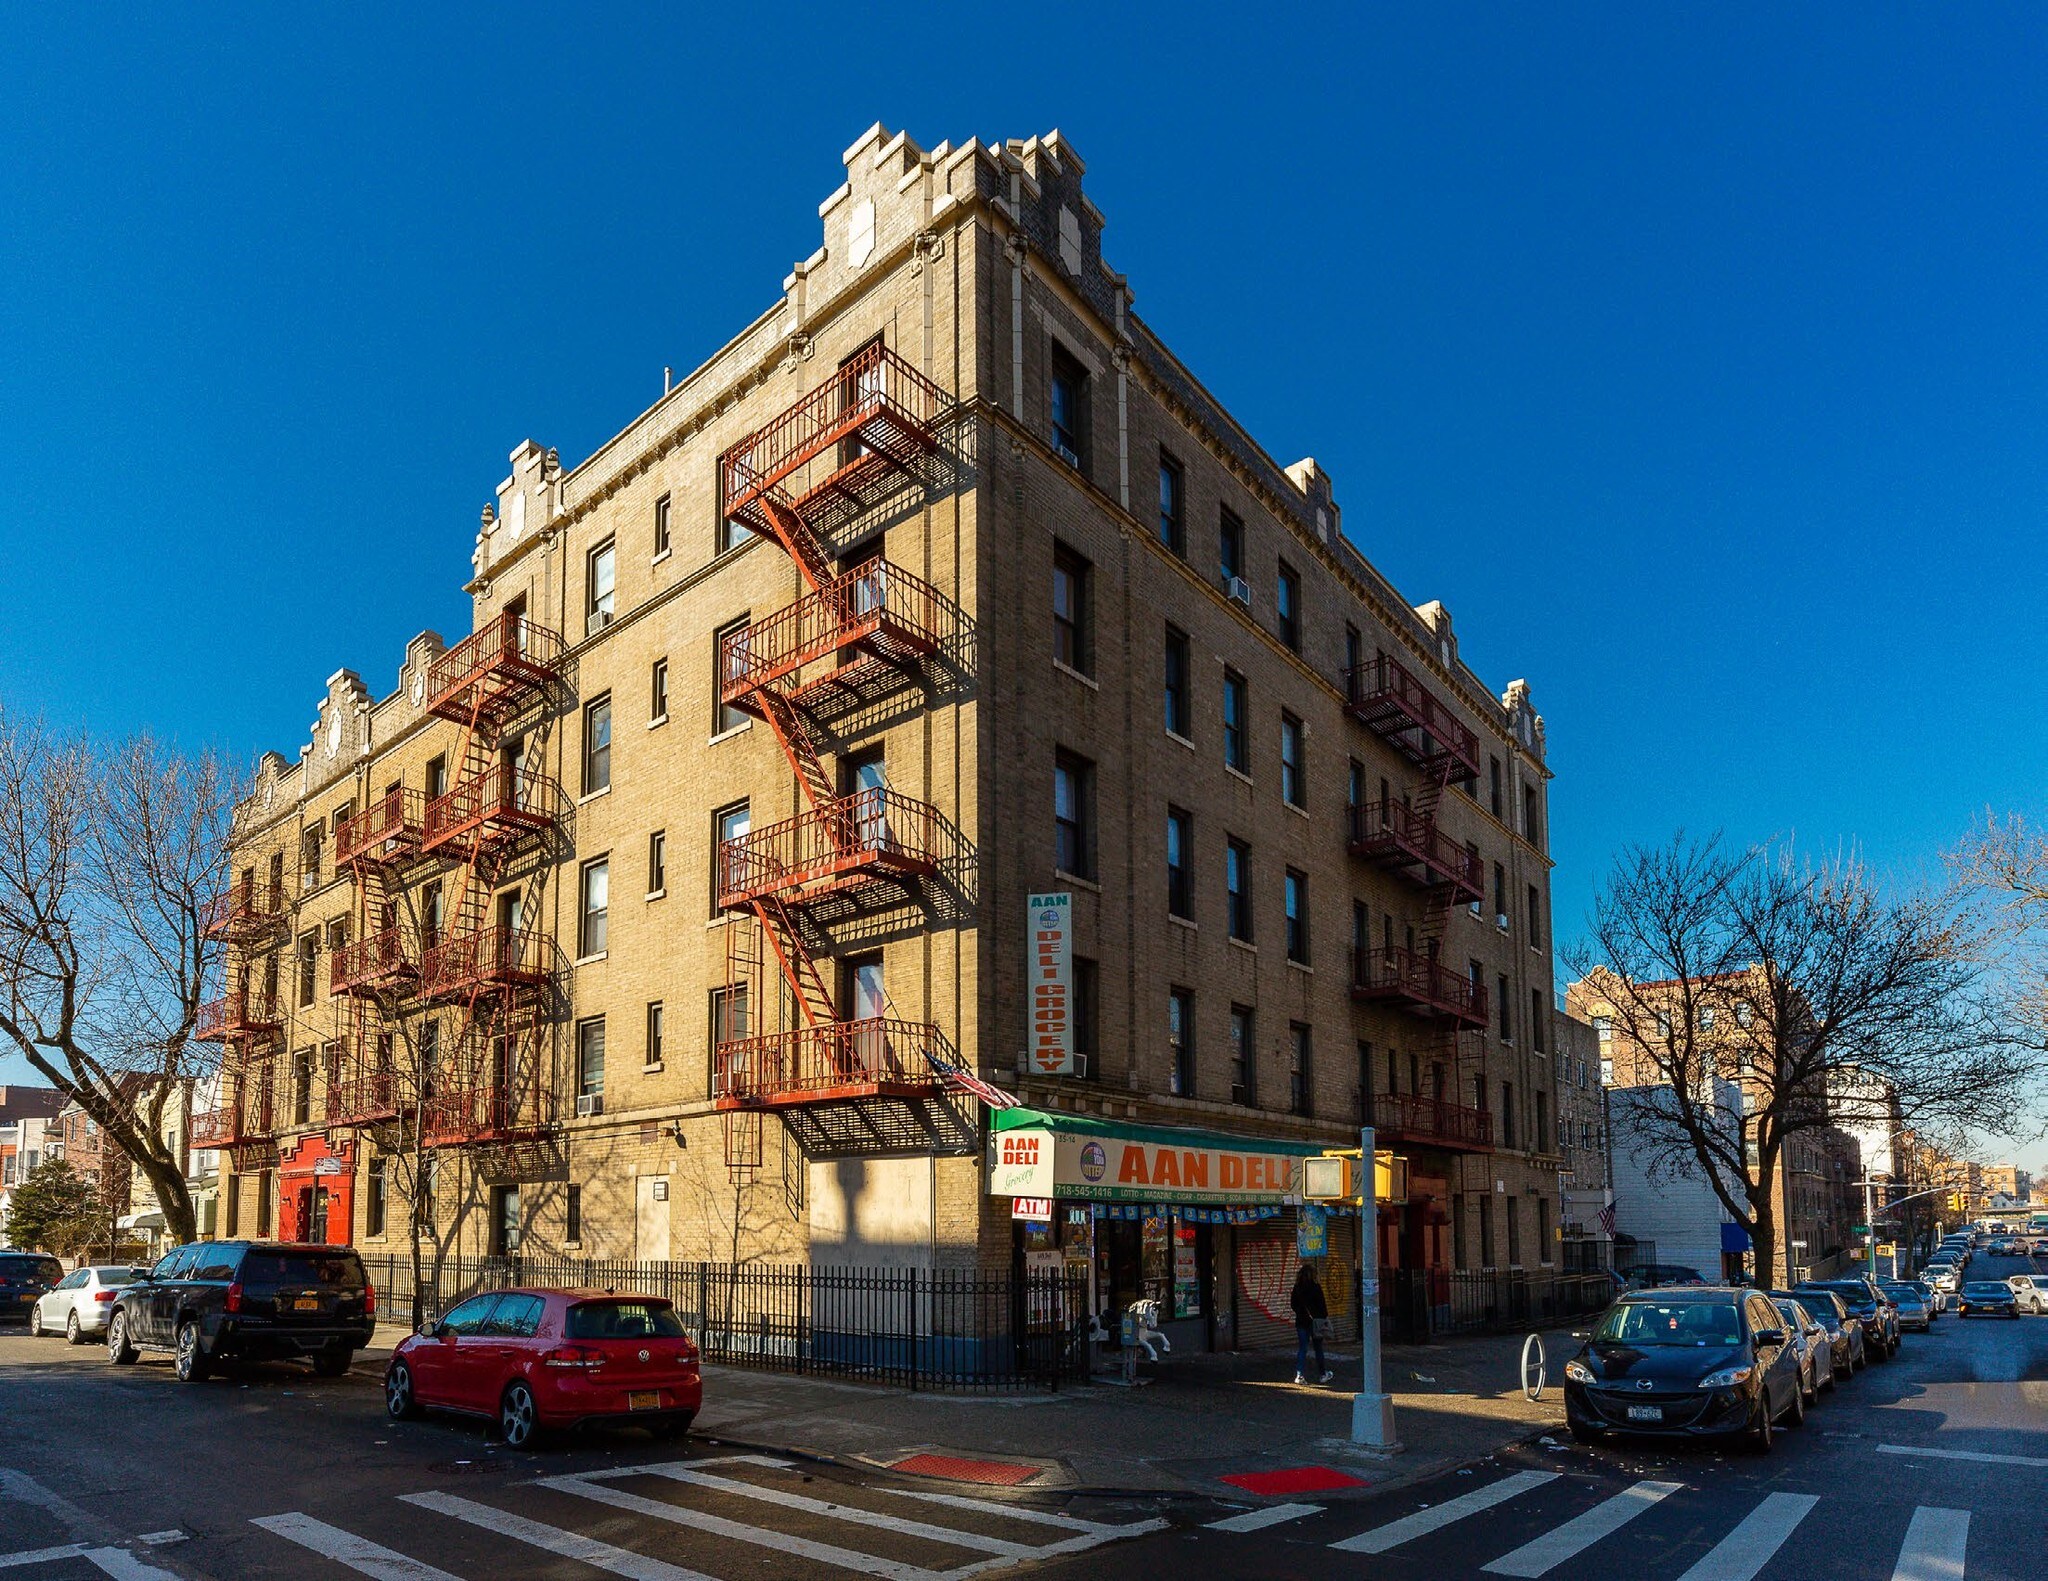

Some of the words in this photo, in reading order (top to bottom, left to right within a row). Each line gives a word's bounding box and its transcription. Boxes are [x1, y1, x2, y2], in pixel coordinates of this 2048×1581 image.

[1031, 895, 1068, 907] AAN
[1036, 931, 1062, 979] DELI
[1035, 985, 1066, 1071] GROCERY
[1003, 1138, 1039, 1150] AAN
[1003, 1152, 1038, 1165] DELI
[1118, 1145, 1208, 1188] AAN
[1219, 1154, 1291, 1190] DELI
[1005, 1167, 1034, 1190] Grocery
[1056, 1186, 1112, 1197] 718-545-1416
[1121, 1189, 1139, 1198] LOTTO
[1144, 1190, 1172, 1200] MAGAZINE
[1017, 1199, 1047, 1214] ATM
